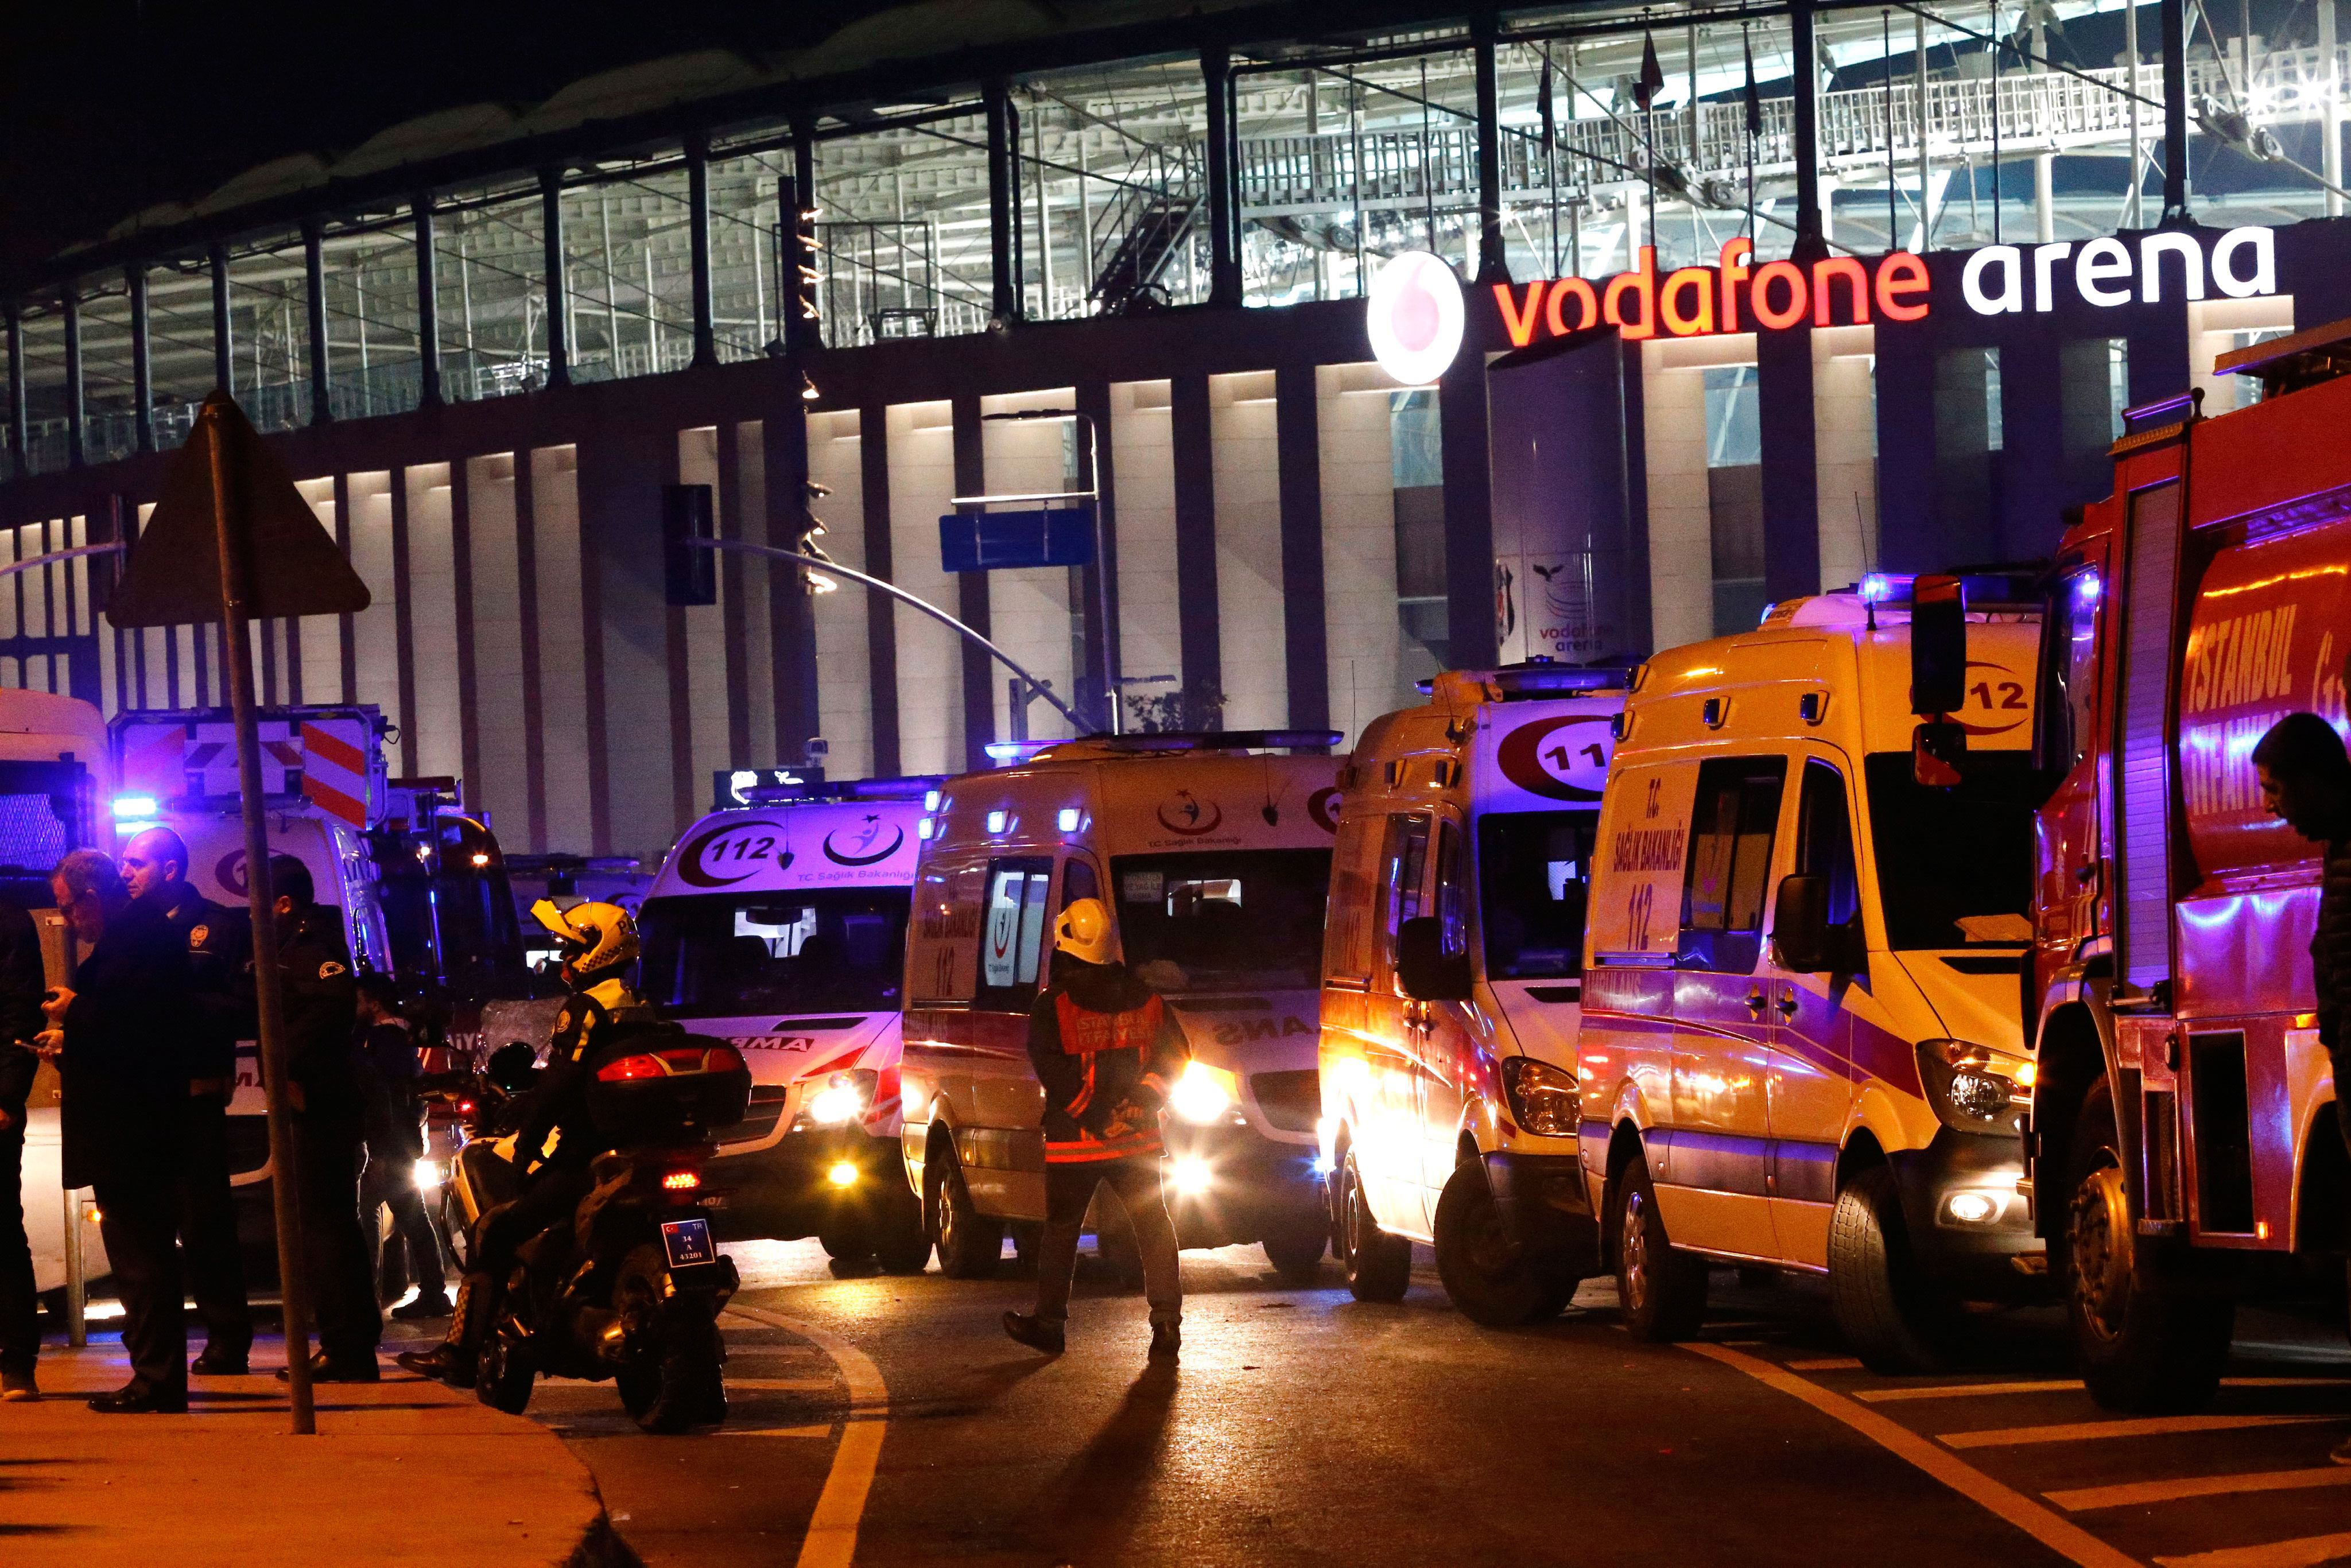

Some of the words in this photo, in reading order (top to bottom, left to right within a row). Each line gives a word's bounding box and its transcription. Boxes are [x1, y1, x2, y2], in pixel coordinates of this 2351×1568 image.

[1492, 237, 1930, 347] vodafone
[1962, 226, 2276, 316] arena
[1970, 682, 2028, 709] 12
[1544, 743, 1606, 770] 11
[712, 837, 775, 862] 112
[818, 871, 854, 881] Sağlık
[1627, 883, 1652, 951] 112
[936, 947, 955, 996] 112
[680, 1252, 702, 1260] 43201
